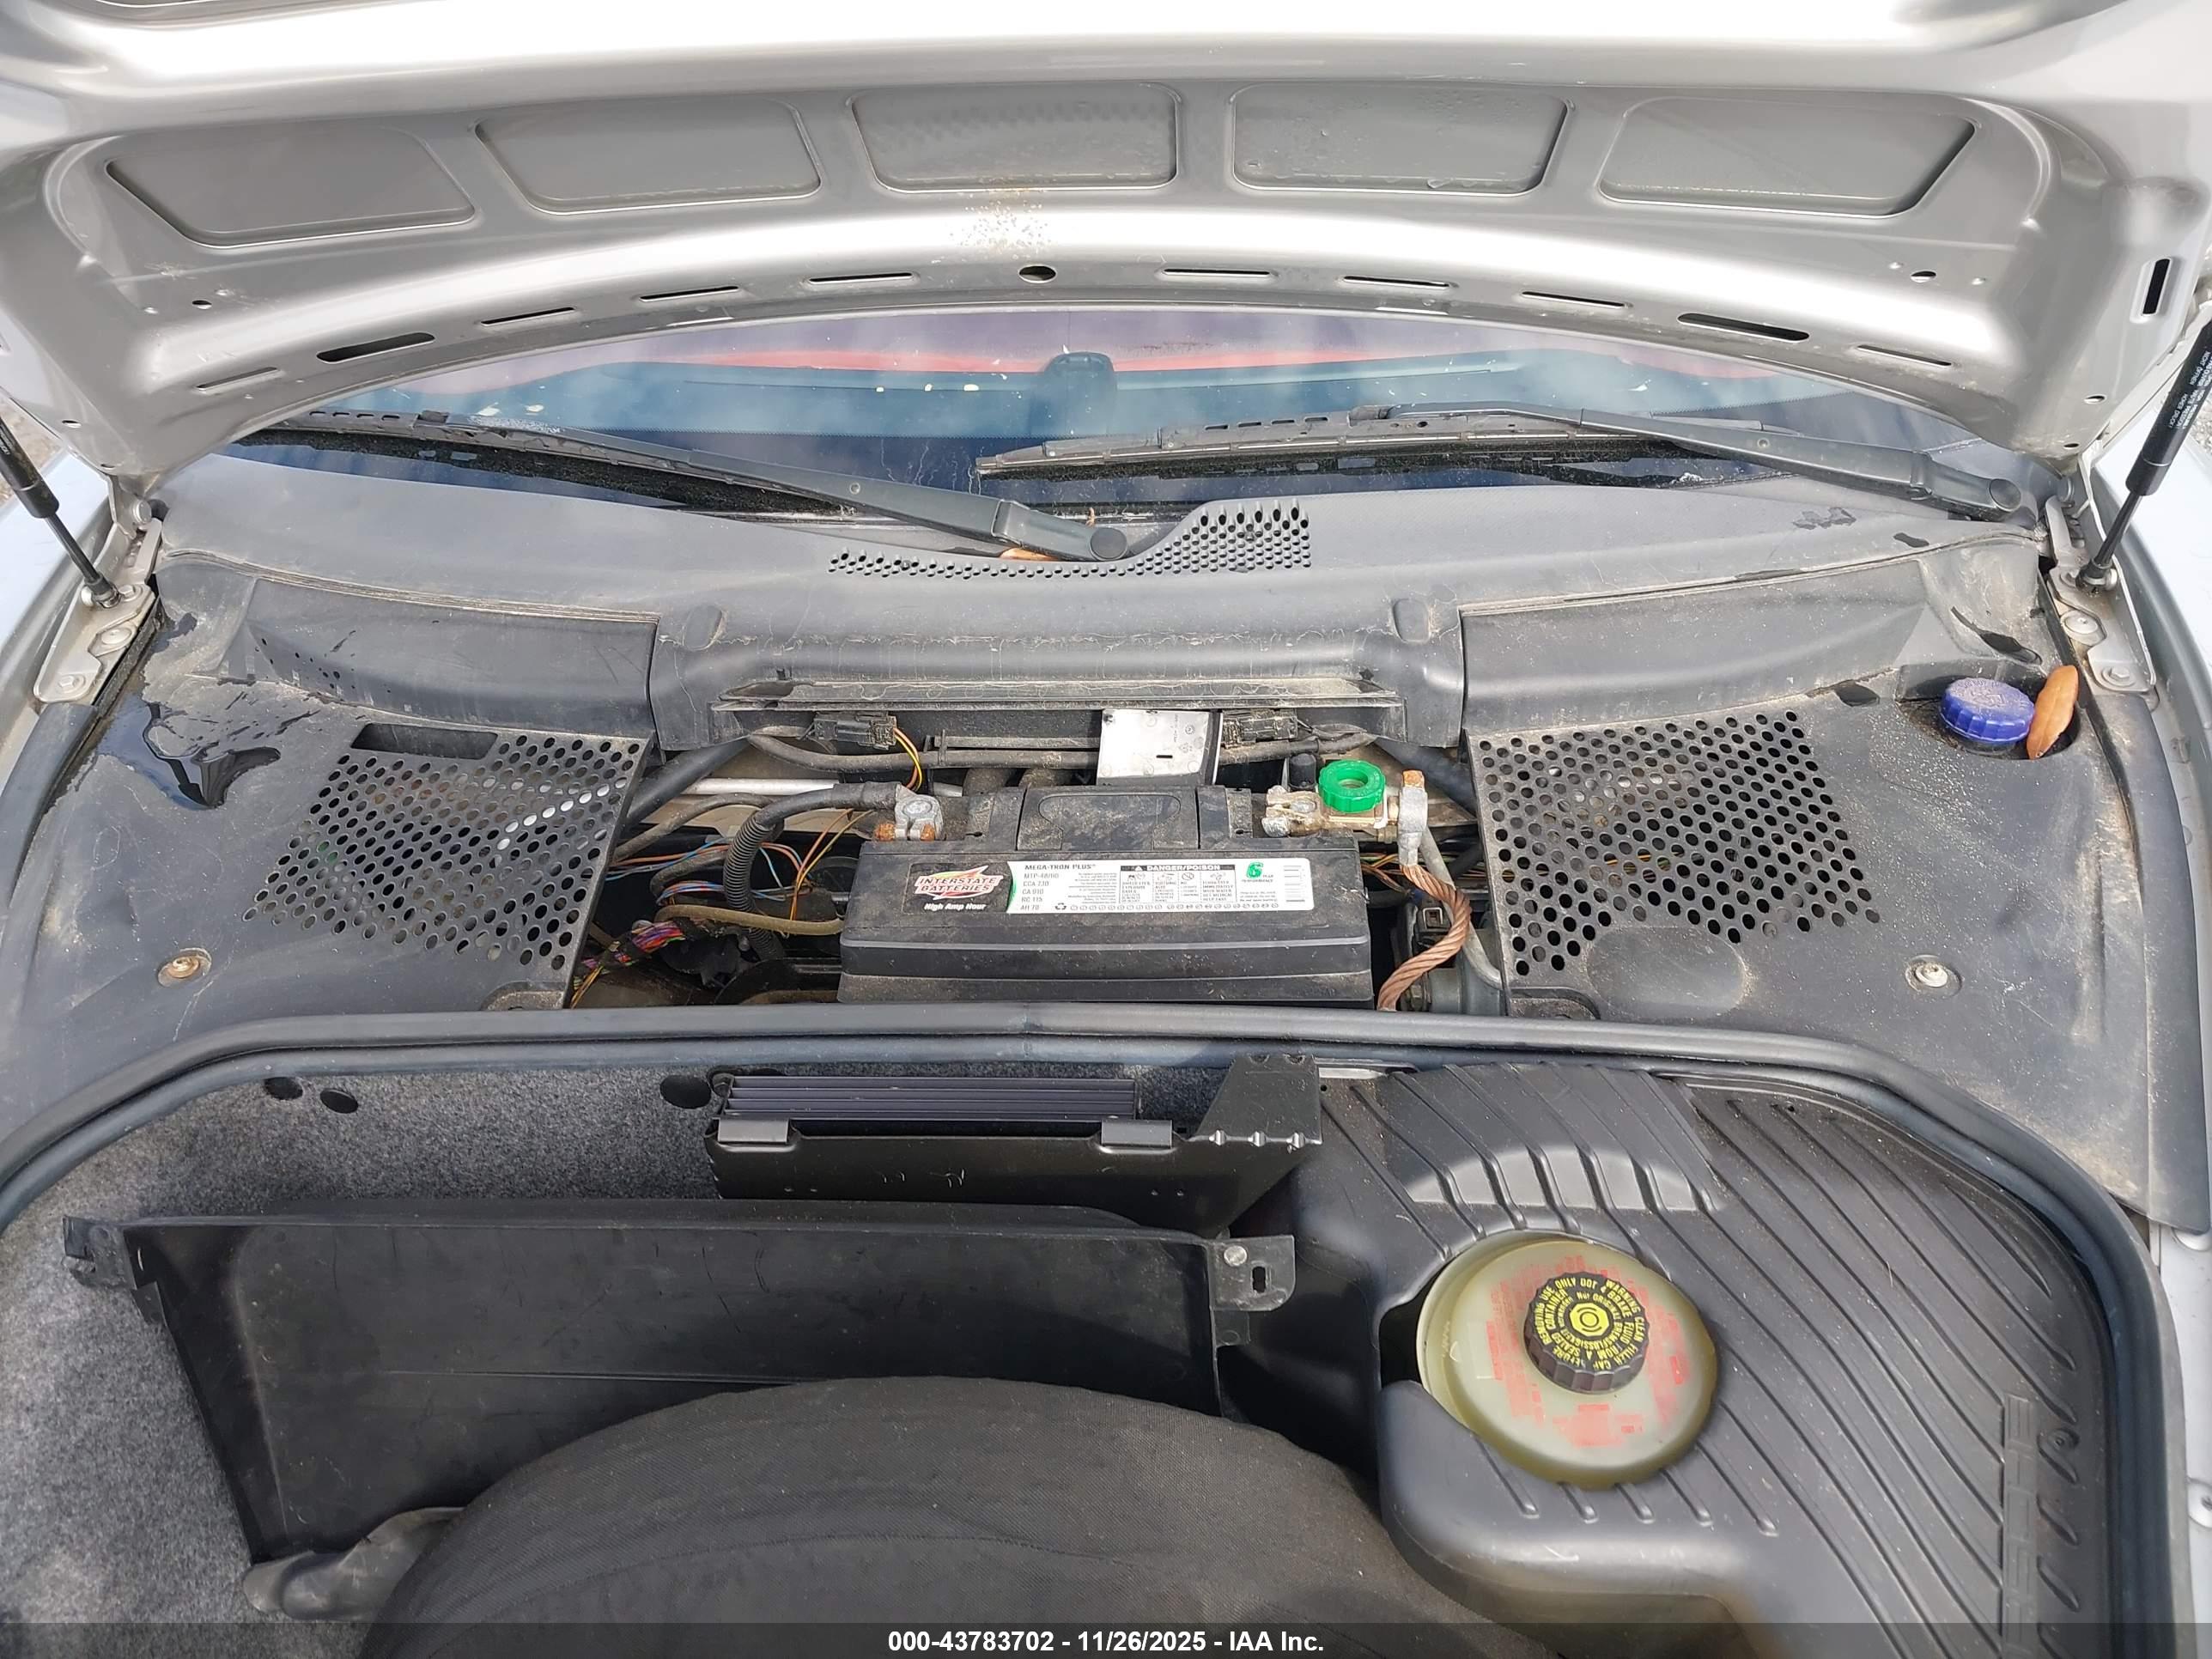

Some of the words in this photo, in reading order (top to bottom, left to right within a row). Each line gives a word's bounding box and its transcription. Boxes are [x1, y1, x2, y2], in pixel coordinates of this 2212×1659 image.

[1247, 862, 1263, 878] 6
[924, 902, 944, 912] High
[1540, 1285, 1555, 1300] USE
[1554, 1278, 1577, 1289] ONLY
[1580, 1278, 1598, 1289] DOT
[1606, 1279, 1641, 1314] WARNING
[1607, 1290, 1633, 1318] BRAKE
[1545, 1289, 1568, 1329] CONTAINER
[1534, 1302, 1553, 1345] REMOVING
[1620, 1322, 1634, 1345] FLUID
[1633, 1316, 1645, 1342] CLEAN
[1551, 1332, 1580, 1357] SEALED
[1585, 1350, 1592, 1360] A
[1597, 1341, 1623, 1360] FROM
[1613, 1343, 1638, 1365] FILLER
